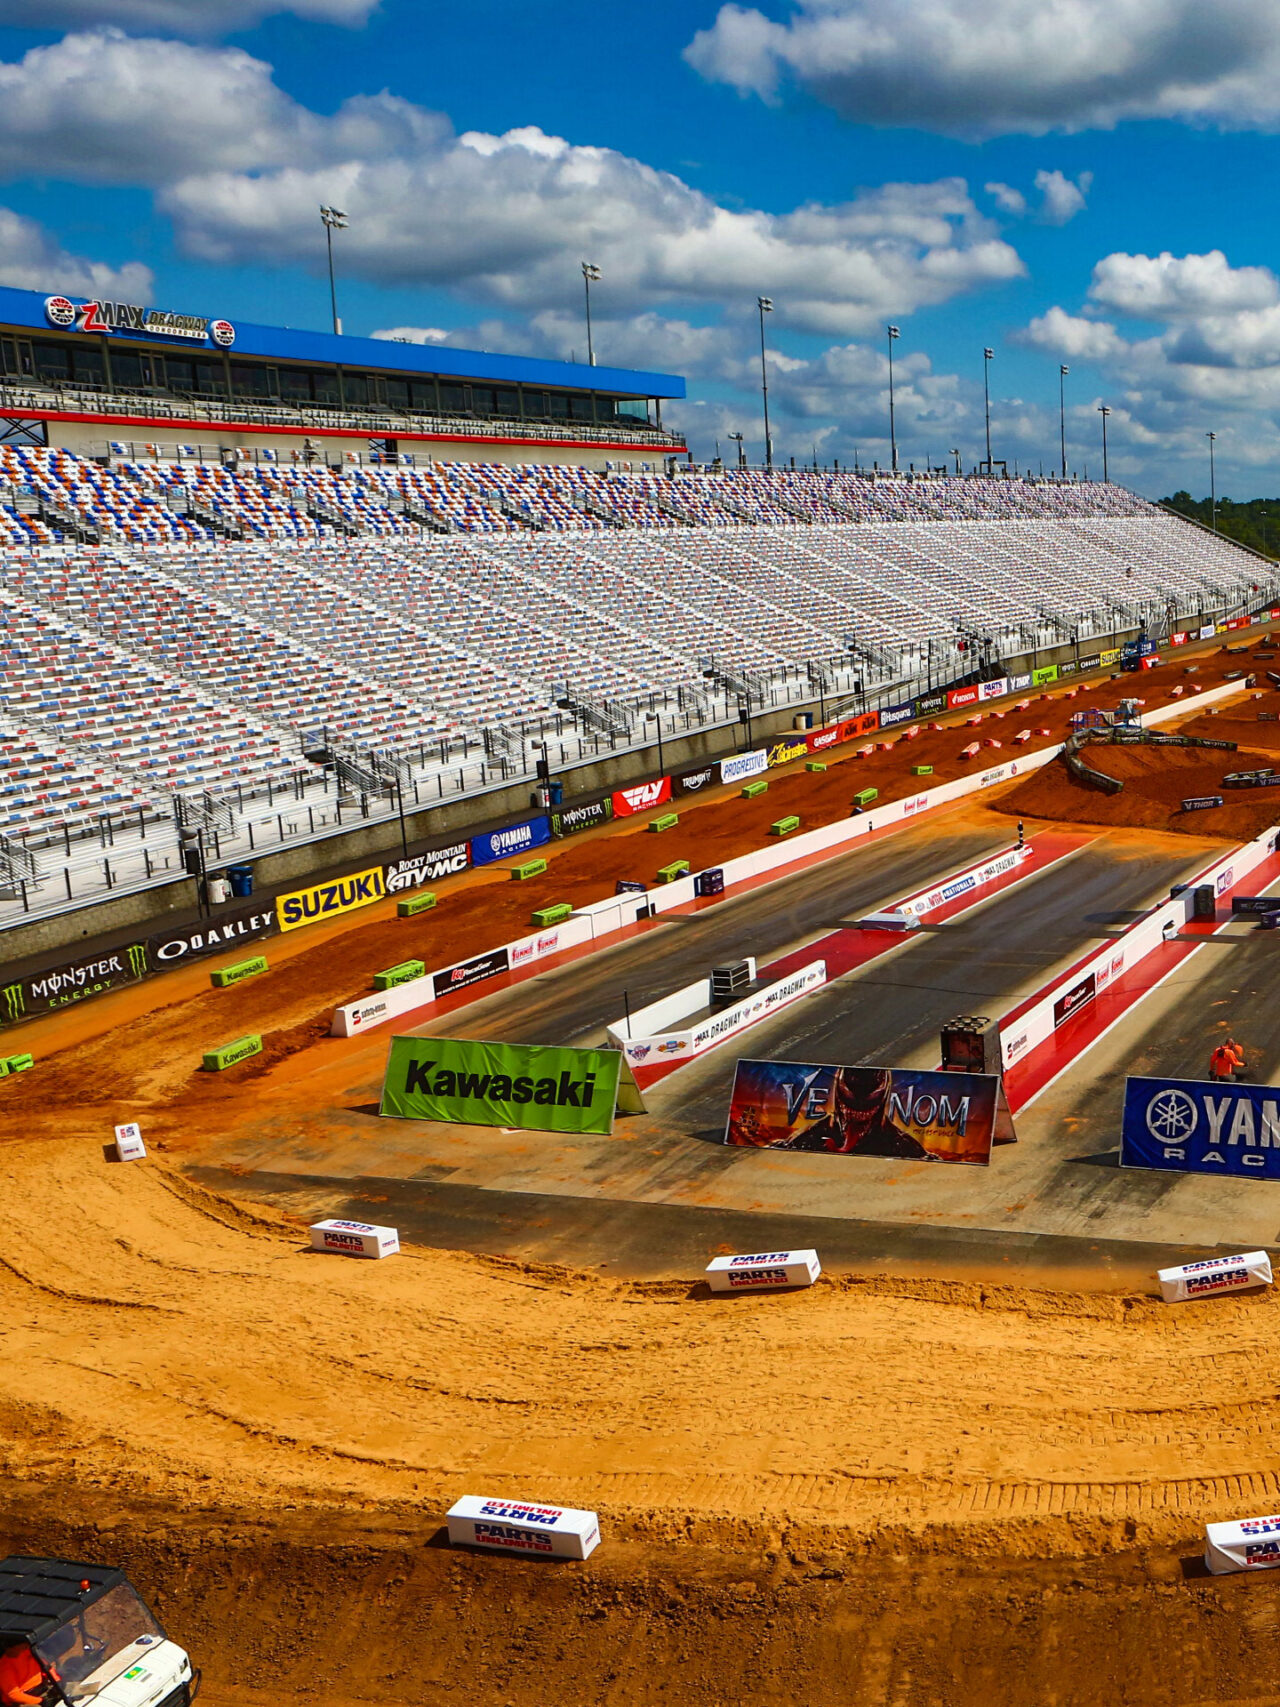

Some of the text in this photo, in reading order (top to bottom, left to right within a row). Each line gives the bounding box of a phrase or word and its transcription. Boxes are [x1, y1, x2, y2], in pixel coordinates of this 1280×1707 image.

[148, 311, 209, 332] DRAGWAY
[983, 681, 1003, 691] PARTS
[813, 731, 837, 748] GASGAS
[724, 753, 765, 778] PROGRESSIVE
[622, 780, 664, 807] FLY
[563, 804, 602, 825] MONSTER
[1193, 800, 1214, 809] THOR
[500, 825, 532, 848] YAMAHA
[399, 843, 467, 872] ROCKY MOUNTAIN
[283, 872, 382, 923] SUZUKI
[191, 911, 275, 950] OAKLEY
[31, 956, 123, 998] MONSTER
[226, 960, 264, 981] Kawasaki
[50, 980, 112, 1007] ENERGY
[779, 976, 806, 1001] DRAGWAY
[711, 1011, 741, 1039] DRAGWAY
[223, 1040, 259, 1065] Kawasaki
[405, 1059, 596, 1107] Kawasaki
[323, 1233, 363, 1246] PARTS
[325, 1241, 364, 1252] UNLIMITED
[732, 1253, 790, 1263] PARTS
[728, 1269, 786, 1281] PARTS
[730, 1277, 788, 1287] UNLIMITED
[1186, 1268, 1248, 1288] PARTS
[1187, 1277, 1249, 1294] UNLIMITED
[480, 1505, 558, 1525] PARTS
[486, 1501, 563, 1517] UNLIMITED
[474, 1523, 552, 1545] PARTS
[475, 1535, 553, 1552] UNLIMITED
